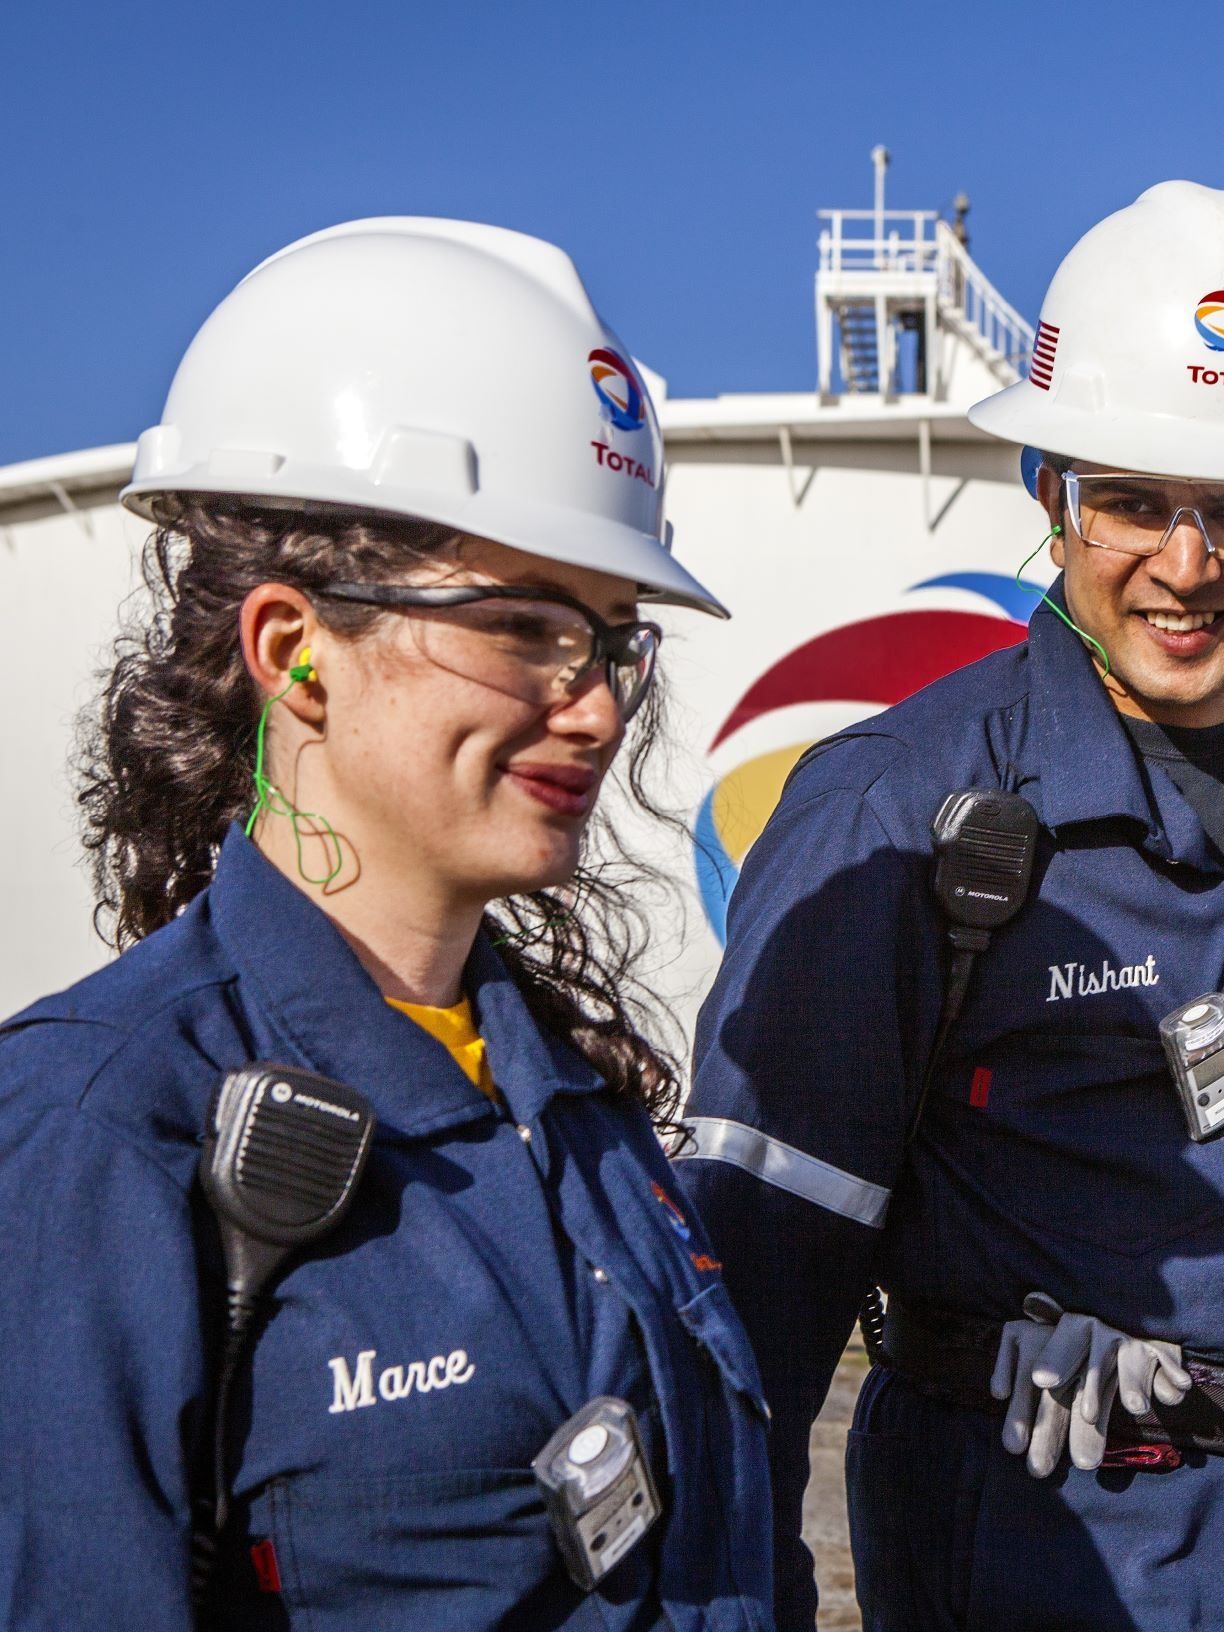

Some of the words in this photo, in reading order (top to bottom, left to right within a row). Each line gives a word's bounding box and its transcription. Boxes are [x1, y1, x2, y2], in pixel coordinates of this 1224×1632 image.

[591, 441, 655, 488] TOTAL
[967, 890, 1009, 902] MOTOROLA
[1046, 954, 1160, 1002] Nishant
[328, 1349, 476, 1414] Marce
